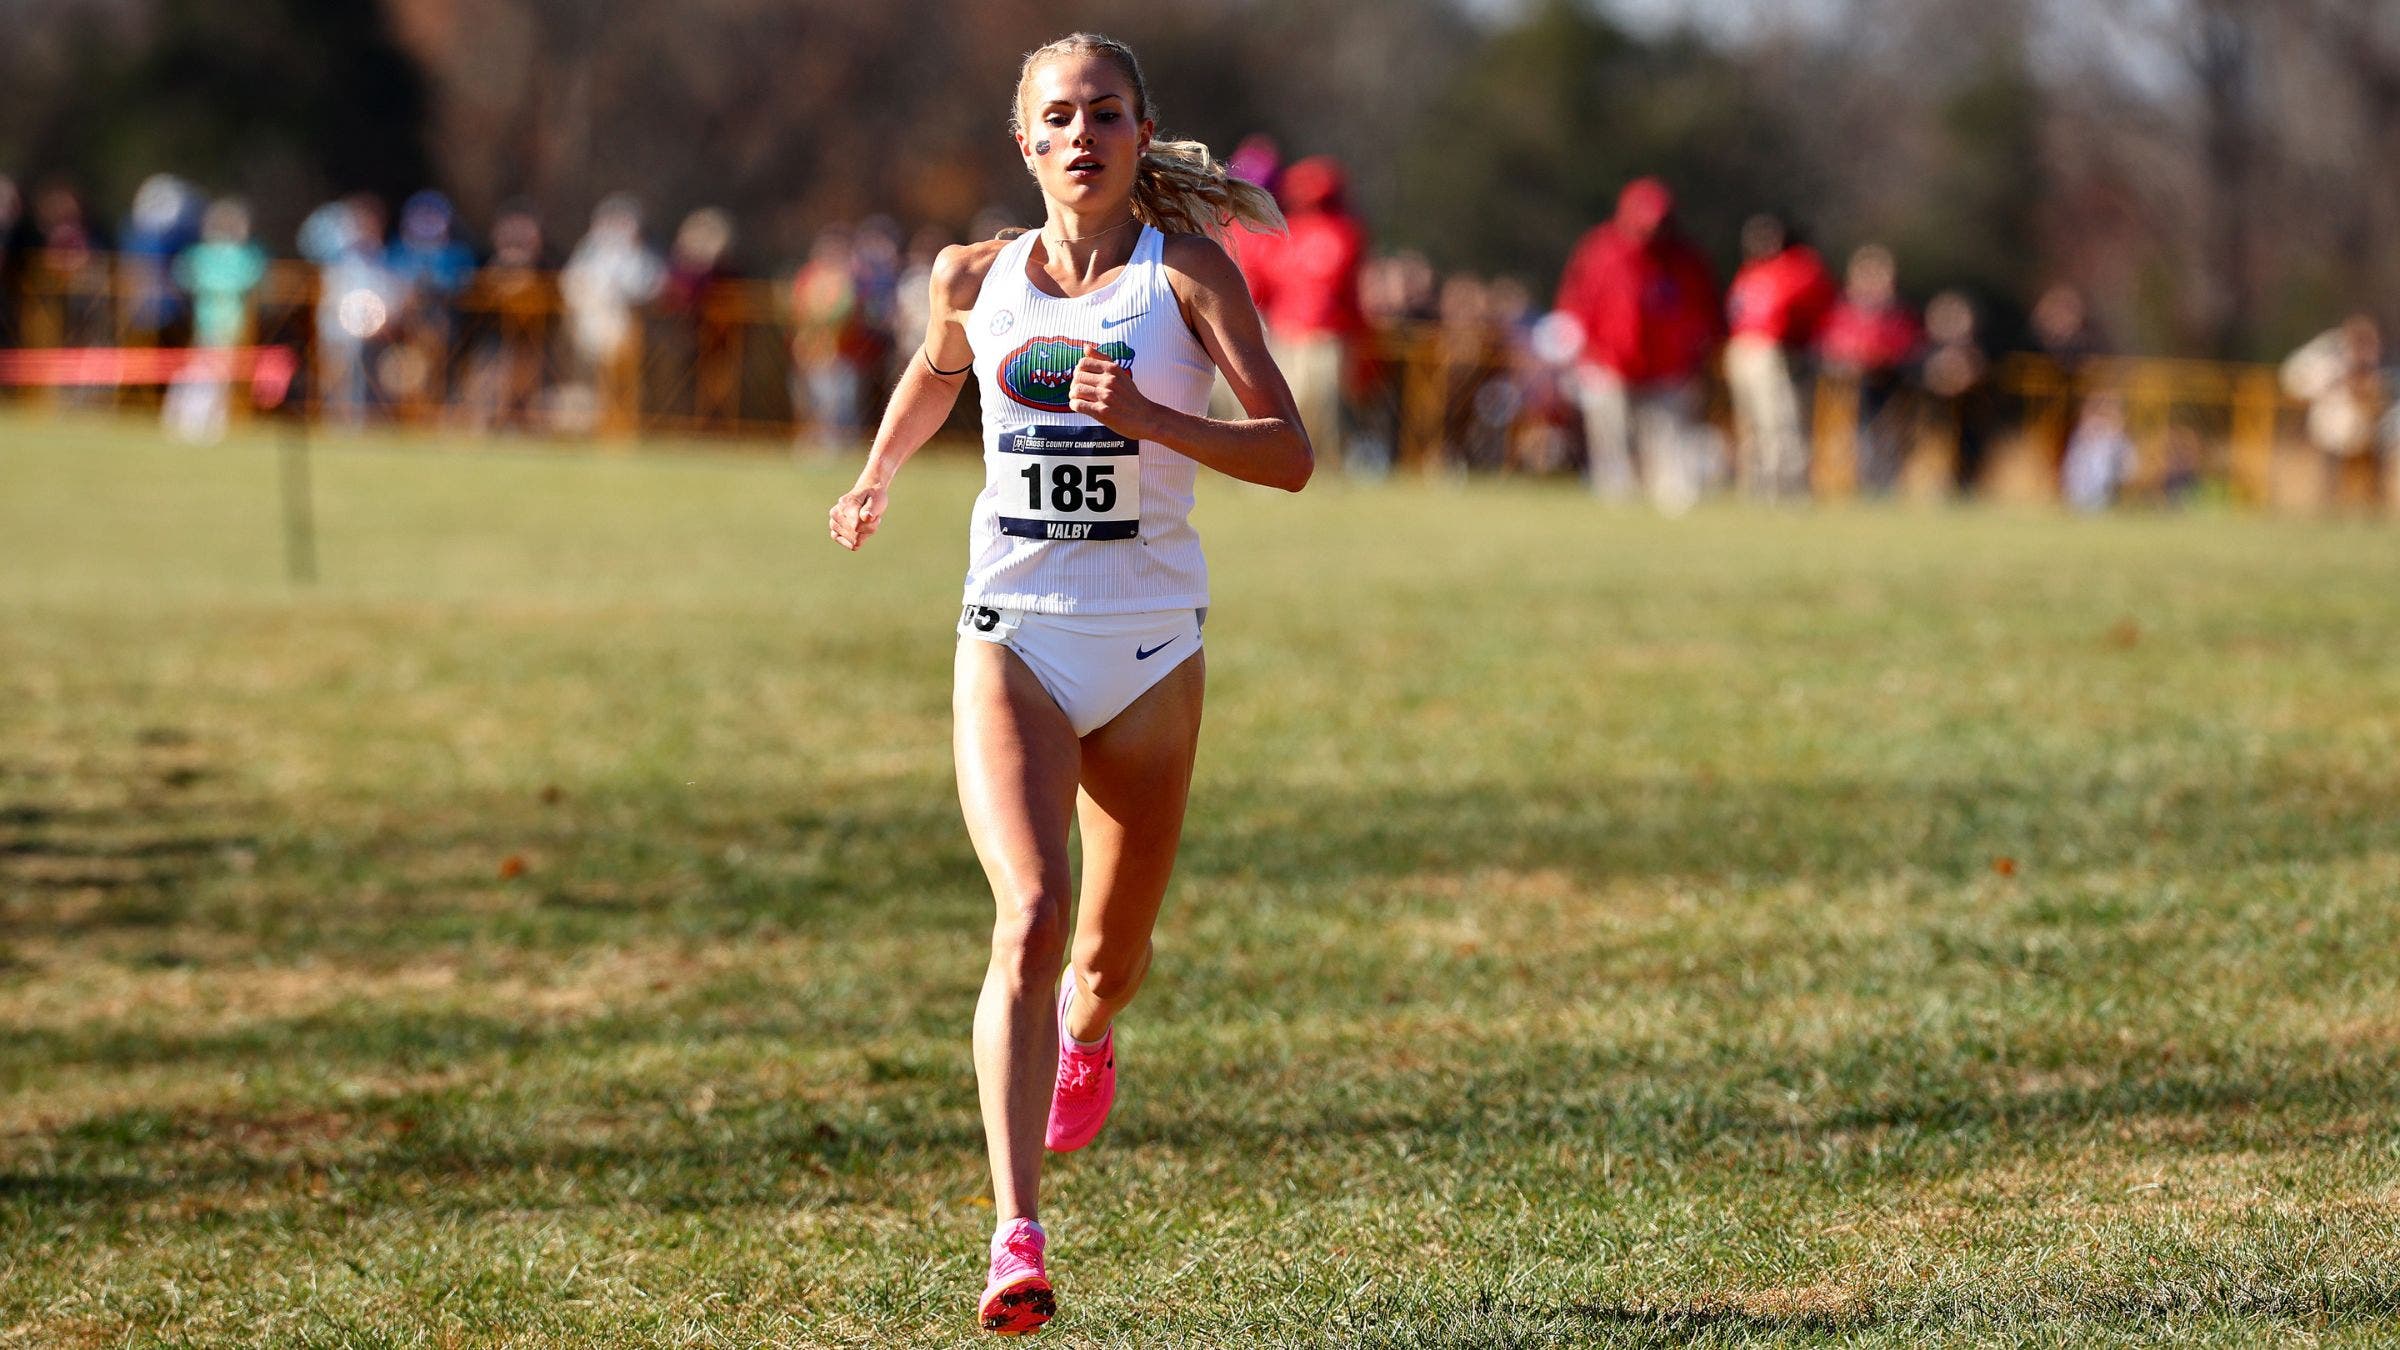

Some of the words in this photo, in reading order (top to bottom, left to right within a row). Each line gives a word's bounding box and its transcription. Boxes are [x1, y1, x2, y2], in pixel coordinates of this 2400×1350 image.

[1025, 440, 1045, 448] CROSS
[1045, 440, 1074, 448] COUNTRY
[1074, 440, 1125, 448] CHAMPIONSHIPS
[1021, 463, 1117, 512] 185
[1046, 523, 1093, 539] VALBY
